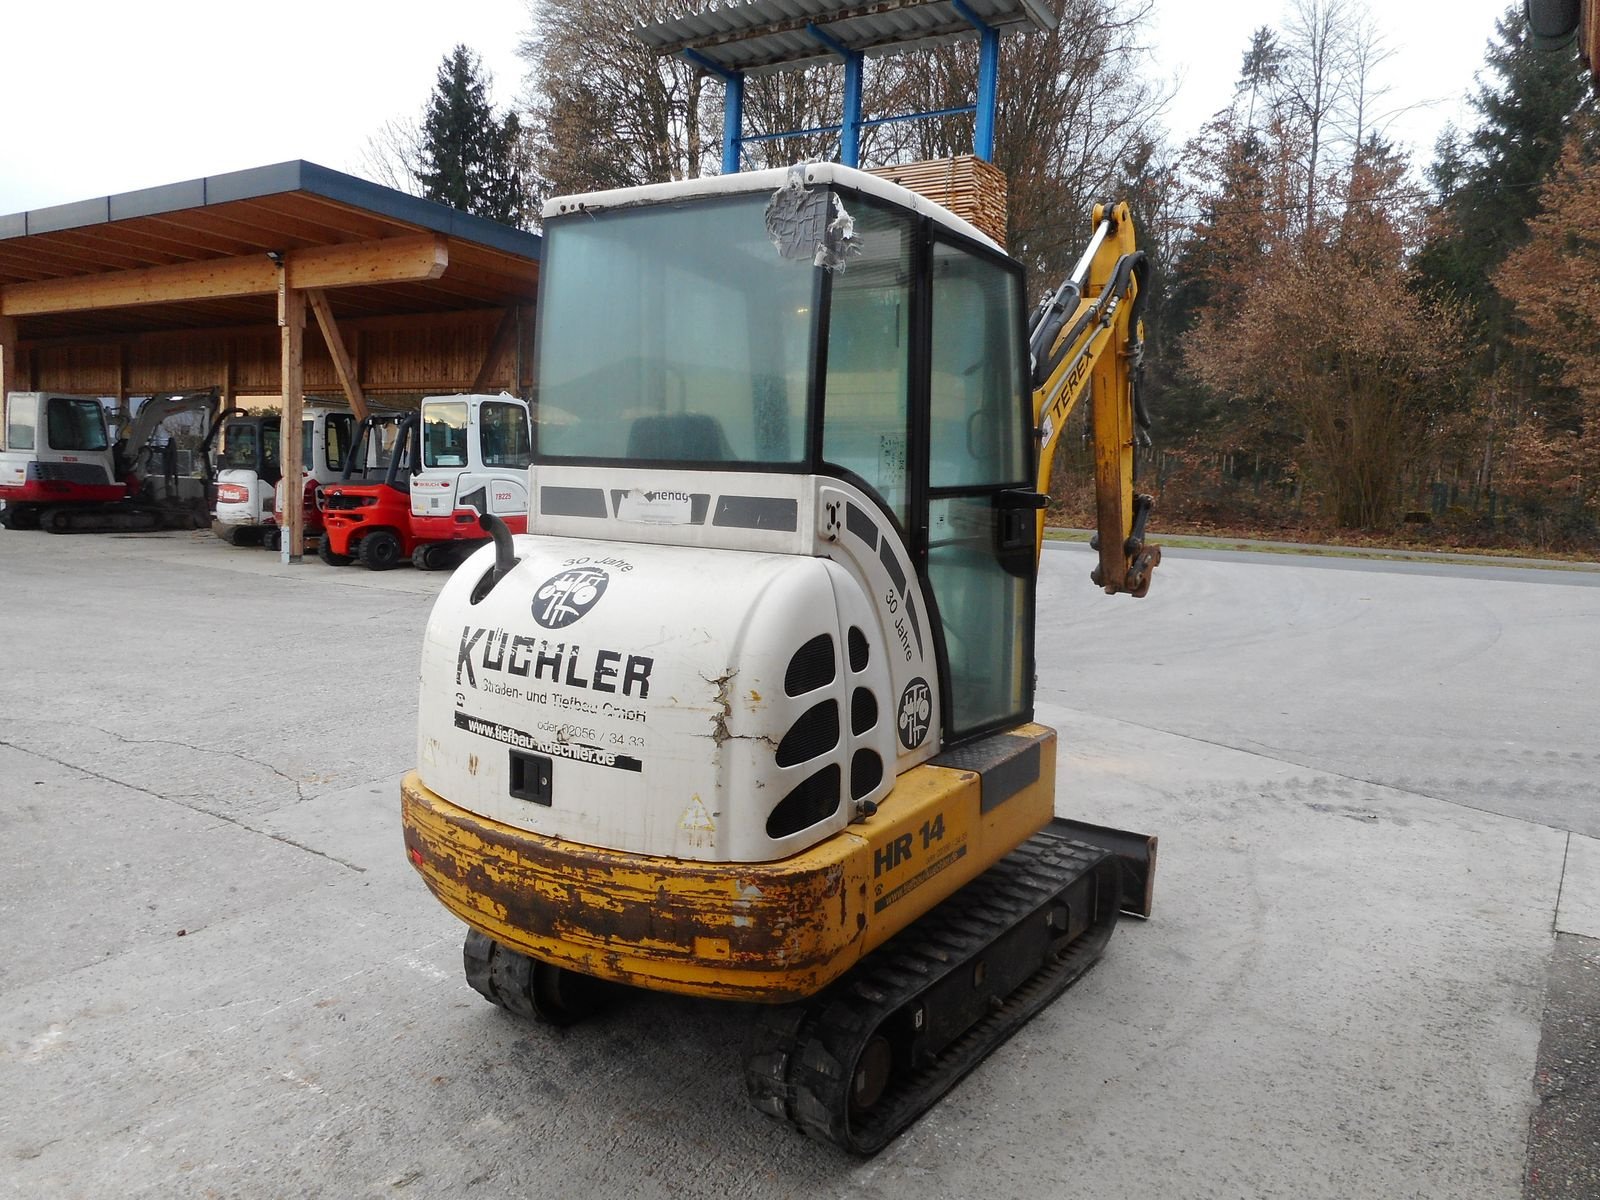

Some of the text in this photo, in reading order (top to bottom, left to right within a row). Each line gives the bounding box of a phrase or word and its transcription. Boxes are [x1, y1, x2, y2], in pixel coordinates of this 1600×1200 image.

[1053, 345, 1094, 418] TEREX
[562, 557, 634, 573] 30 Jahre
[886, 589, 913, 662] 30 Jahre
[455, 625, 655, 700] KÜCHLER
[526, 691, 547, 705] und
[874, 833, 913, 880] HR
[919, 813, 945, 850] 14
